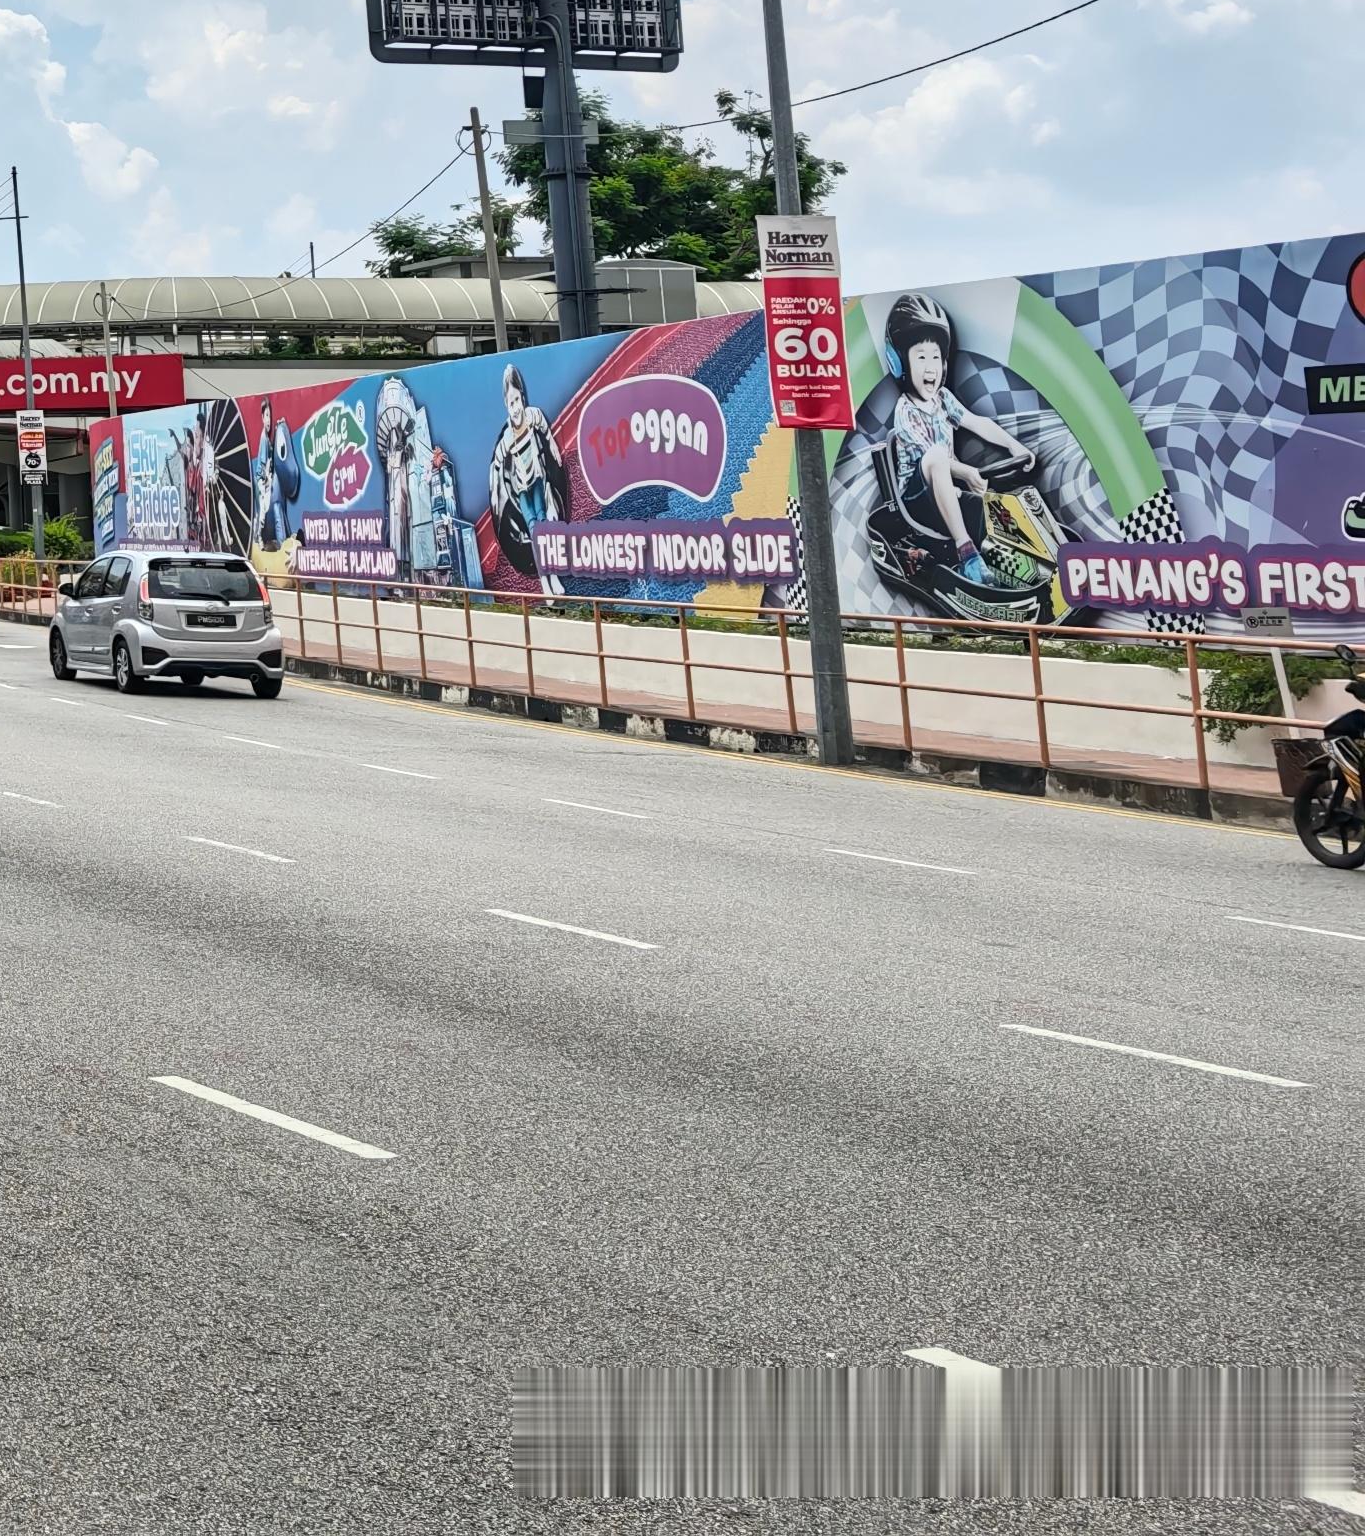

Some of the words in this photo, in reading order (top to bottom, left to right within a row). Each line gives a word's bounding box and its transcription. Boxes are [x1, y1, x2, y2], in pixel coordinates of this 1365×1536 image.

[767, 231, 828, 248] Harvey
[765, 249, 834, 263] Norman
[807, 297, 836, 315] 0%
[774, 327, 838, 361] 60
[777, 364, 841, 377] BULAN
[131, 430, 158, 485] Sky
[132, 480, 180, 540] Bridge
[304, 518, 329, 541] VOTED
[331, 519, 349, 542] NO.1
[351, 519, 382, 542] FAMILY
[298, 549, 347, 572] INTERACTIVE
[349, 551, 396, 576] PLAYLAND
[538, 534, 567, 567] THE
[571, 533, 646, 570] LONGEST
[652, 533, 726, 571] INDOOR
[732, 533, 794, 573] SLIDE
[1069, 553, 1246, 606] PENANG'S
[1259, 562, 1365, 611] FIRST
